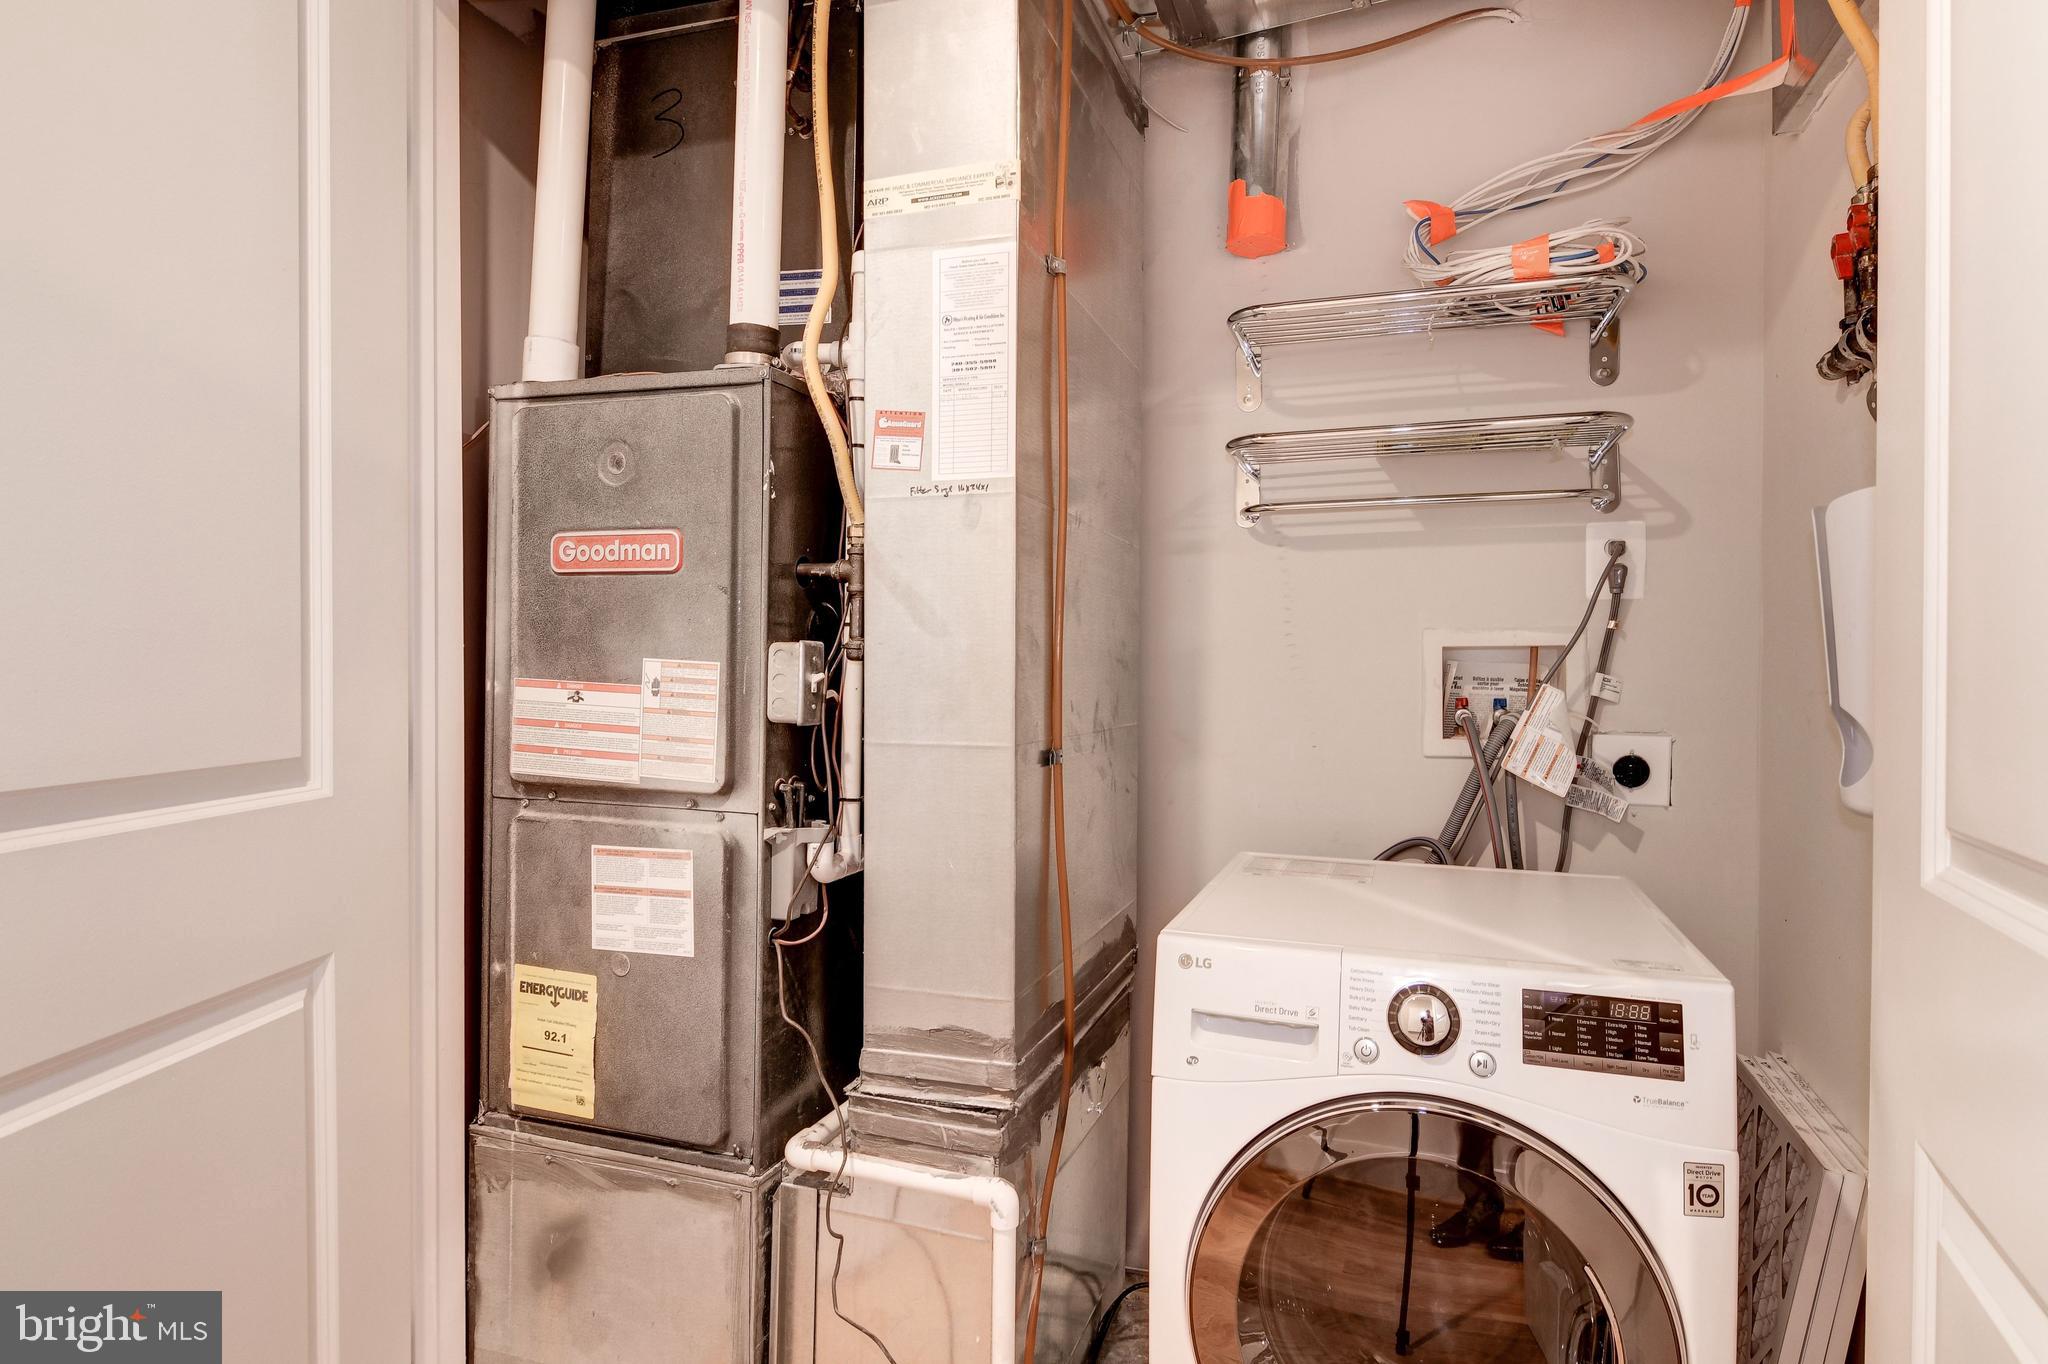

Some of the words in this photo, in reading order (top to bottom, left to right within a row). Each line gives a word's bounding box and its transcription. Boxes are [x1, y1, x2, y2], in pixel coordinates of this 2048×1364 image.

[651, 88, 685, 158] 3
[912, 179, 944, 188] COMMERCIAL
[973, 171, 994, 179] EXPERTS
[867, 198, 888, 207] ARP
[910, 486, 932, 496] Filter
[558, 539, 670, 563] Goodman
[1195, 957, 1212, 969] LG
[520, 981, 588, 1007] ENERGYGUIDE
[1255, 1005, 1277, 1014] Direct
[1279, 1007, 1299, 1017] Drive
[1610, 1004, 1650, 1020] 18:88
[544, 1031, 566, 1043] 92.1
[1643, 1097, 1685, 1107] TrueBalance
[1688, 1184, 1720, 1207] 10
